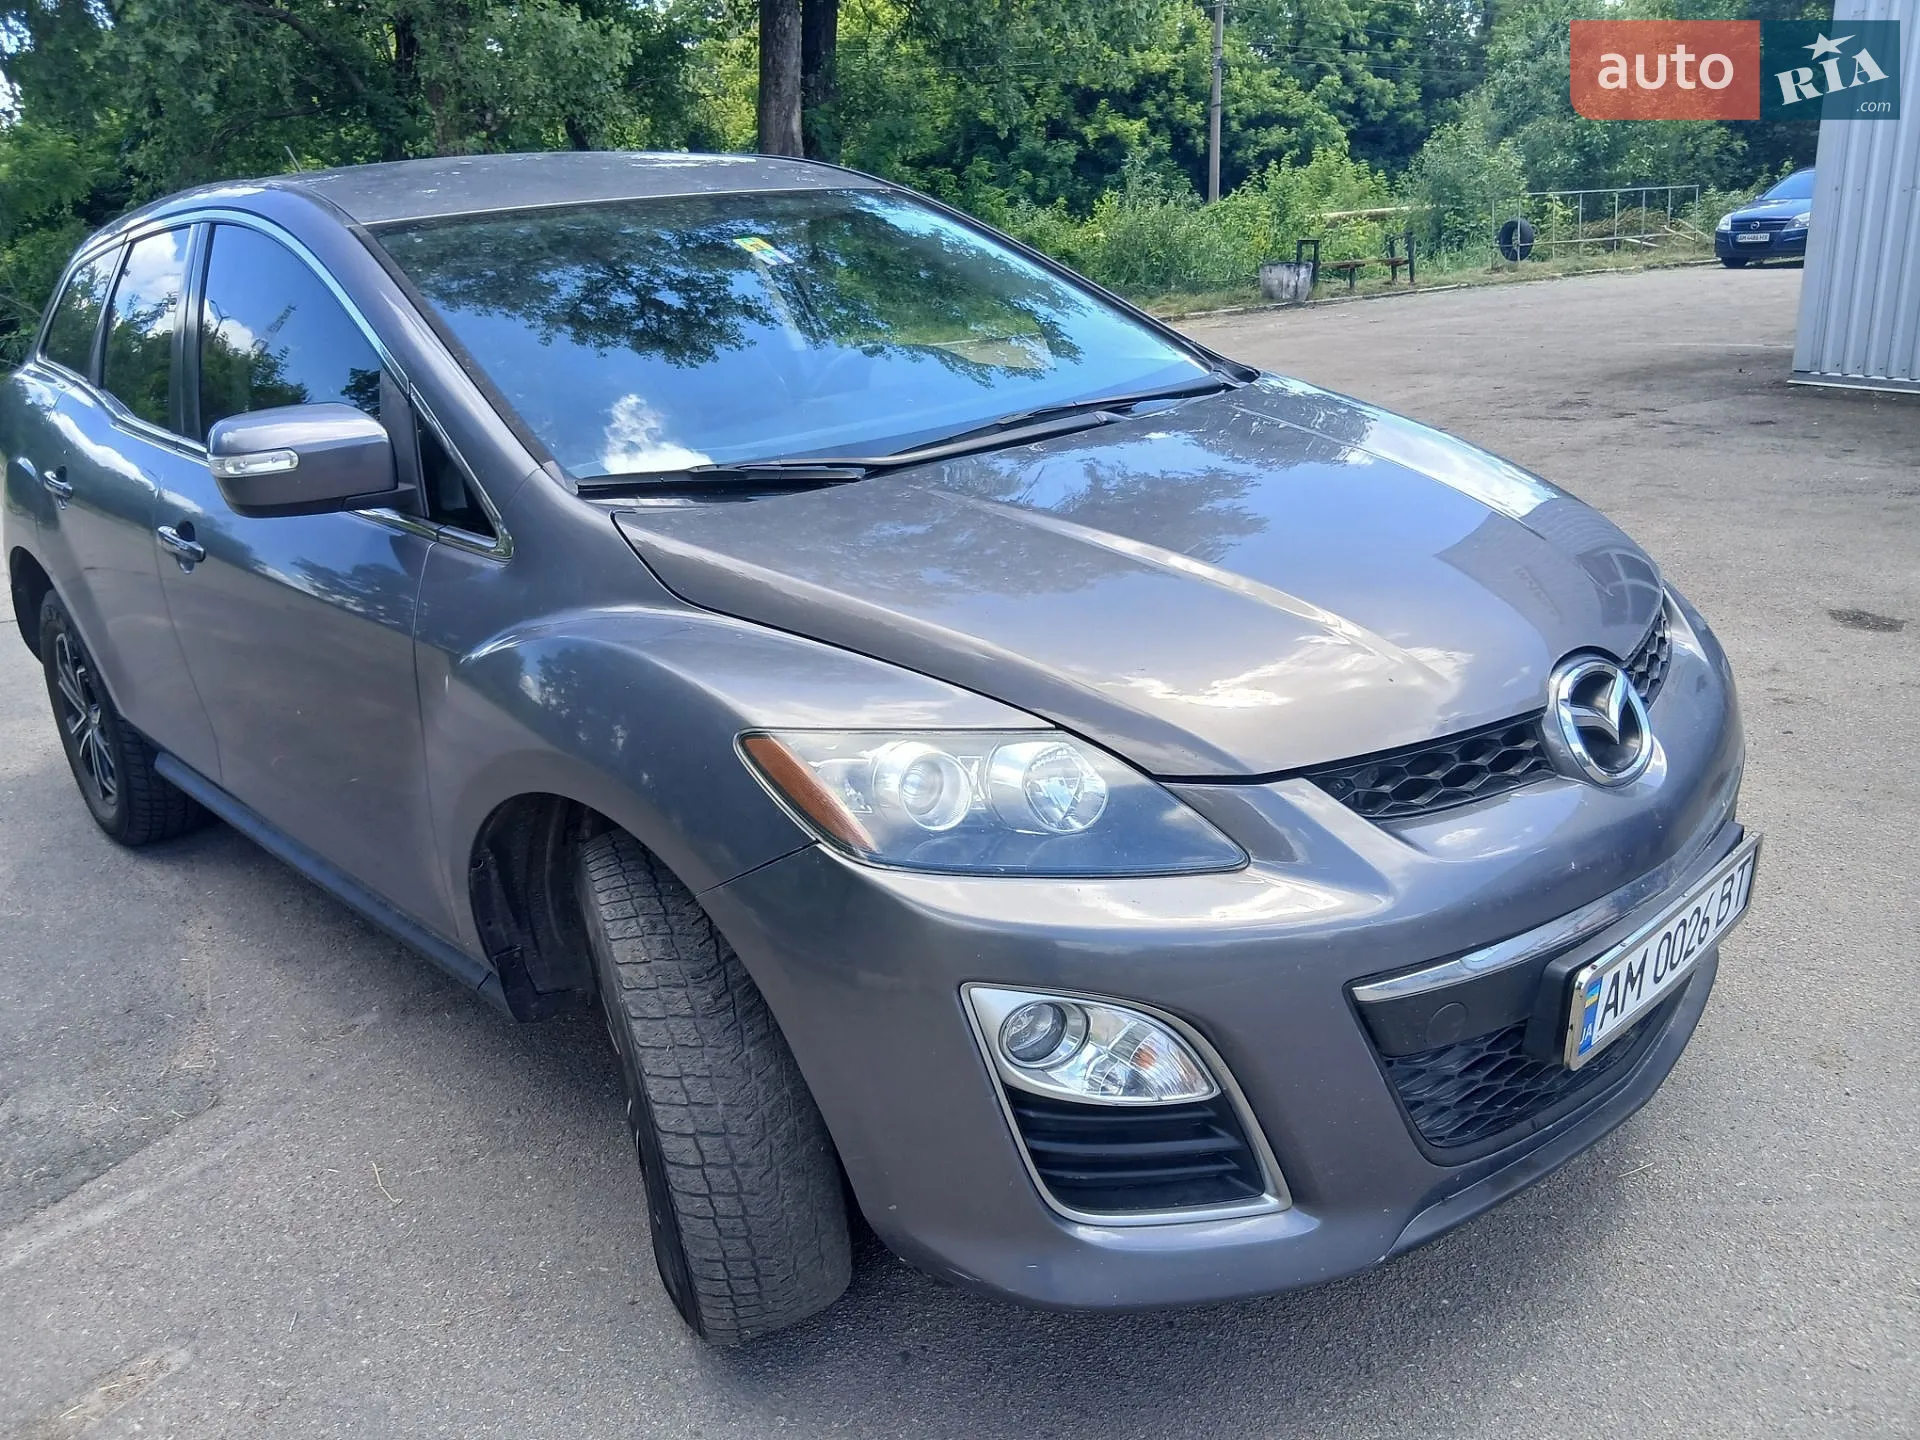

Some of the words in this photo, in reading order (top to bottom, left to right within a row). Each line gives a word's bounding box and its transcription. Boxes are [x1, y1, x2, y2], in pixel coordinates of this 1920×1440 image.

[1598, 948, 1649, 1031] AM
[1653, 890, 1716, 985] 0026
[1715, 856, 1753, 931] BT
